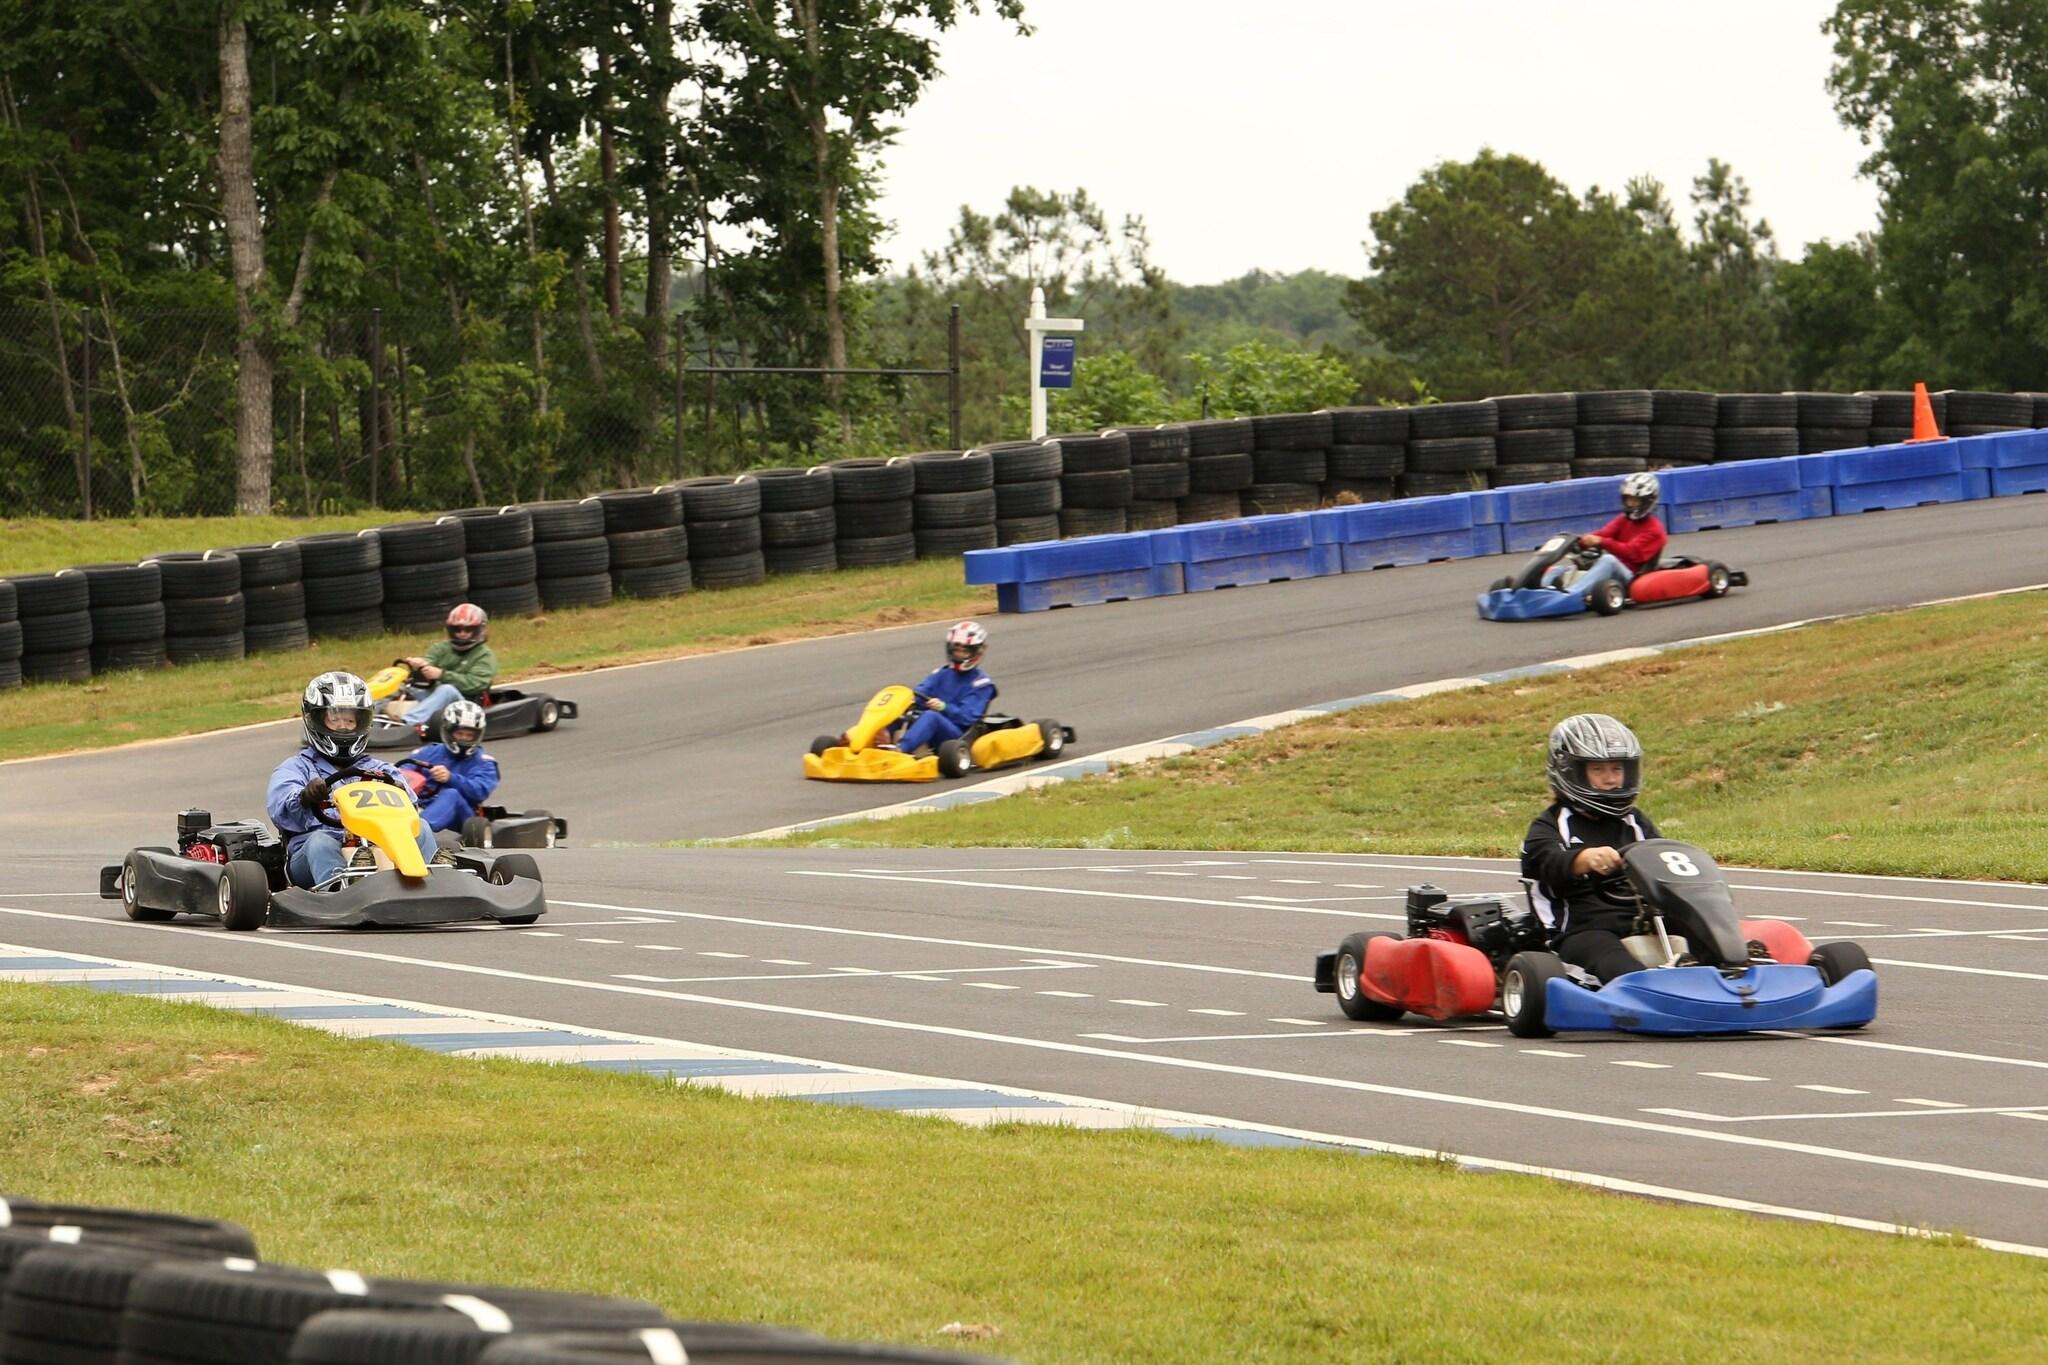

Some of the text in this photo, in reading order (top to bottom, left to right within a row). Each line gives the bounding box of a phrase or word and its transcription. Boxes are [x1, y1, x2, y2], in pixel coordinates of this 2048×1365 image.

[340, 686, 353, 697] 13
[877, 693, 894, 706] 9
[348, 789, 405, 809] 20
[1659, 851, 1700, 877] 8
